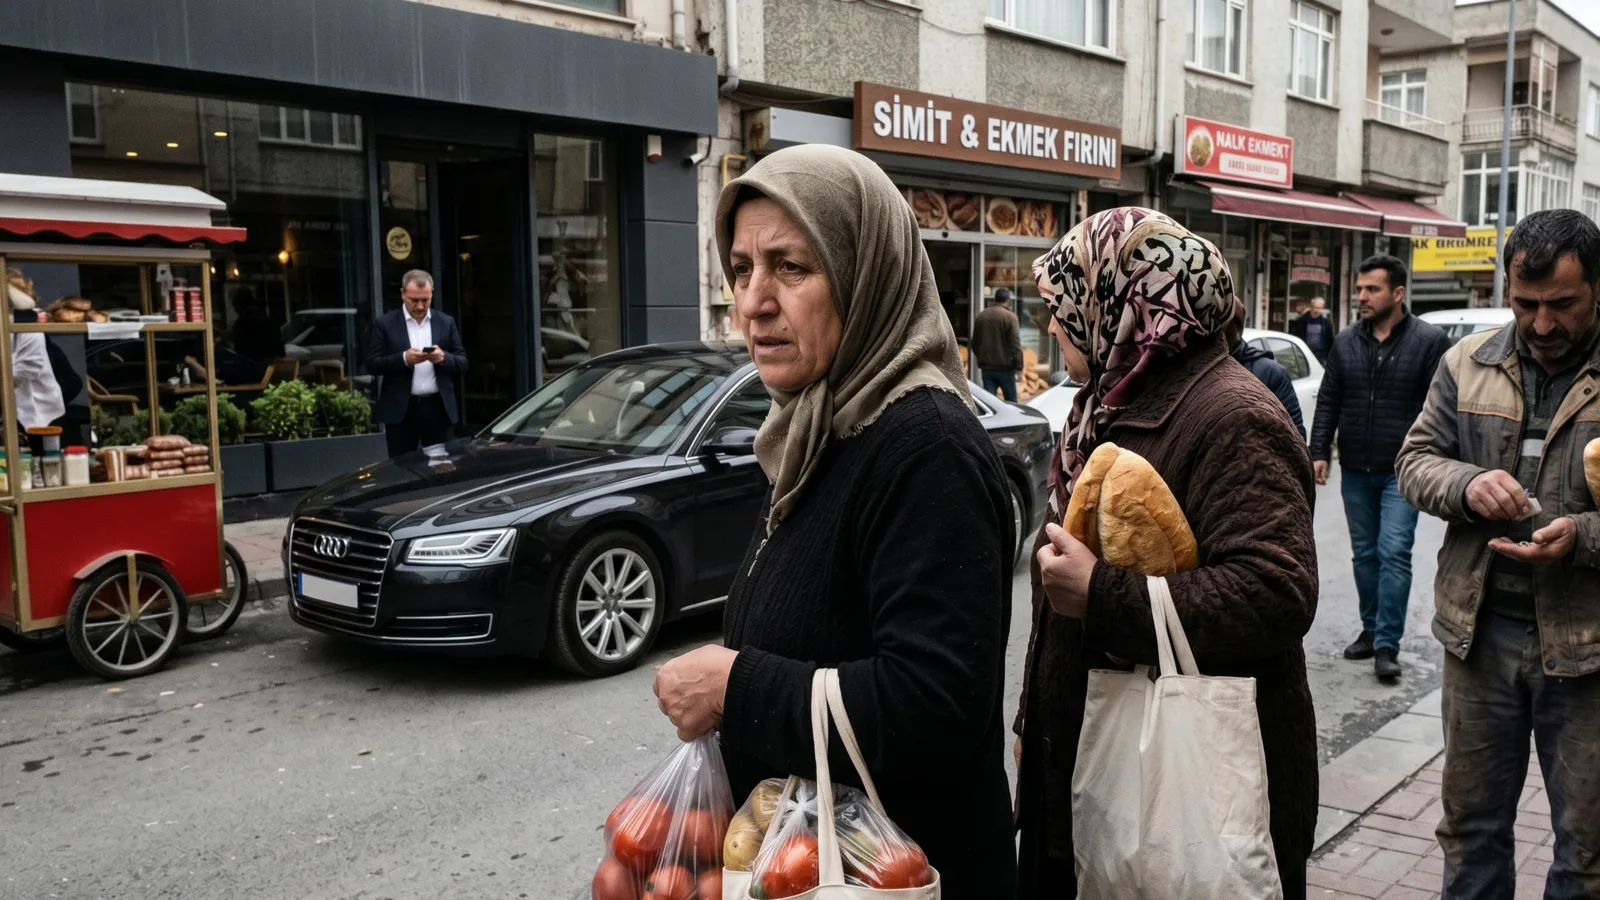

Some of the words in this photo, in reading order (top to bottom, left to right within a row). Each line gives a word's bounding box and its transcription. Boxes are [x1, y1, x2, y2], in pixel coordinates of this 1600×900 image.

[873, 94, 952, 145] SİMİT
[960, 113, 980, 149] &
[987, 117, 1059, 160] EKMEK
[1063, 130, 1117, 169] FIRINI
[1216, 130, 1246, 151] NALK
